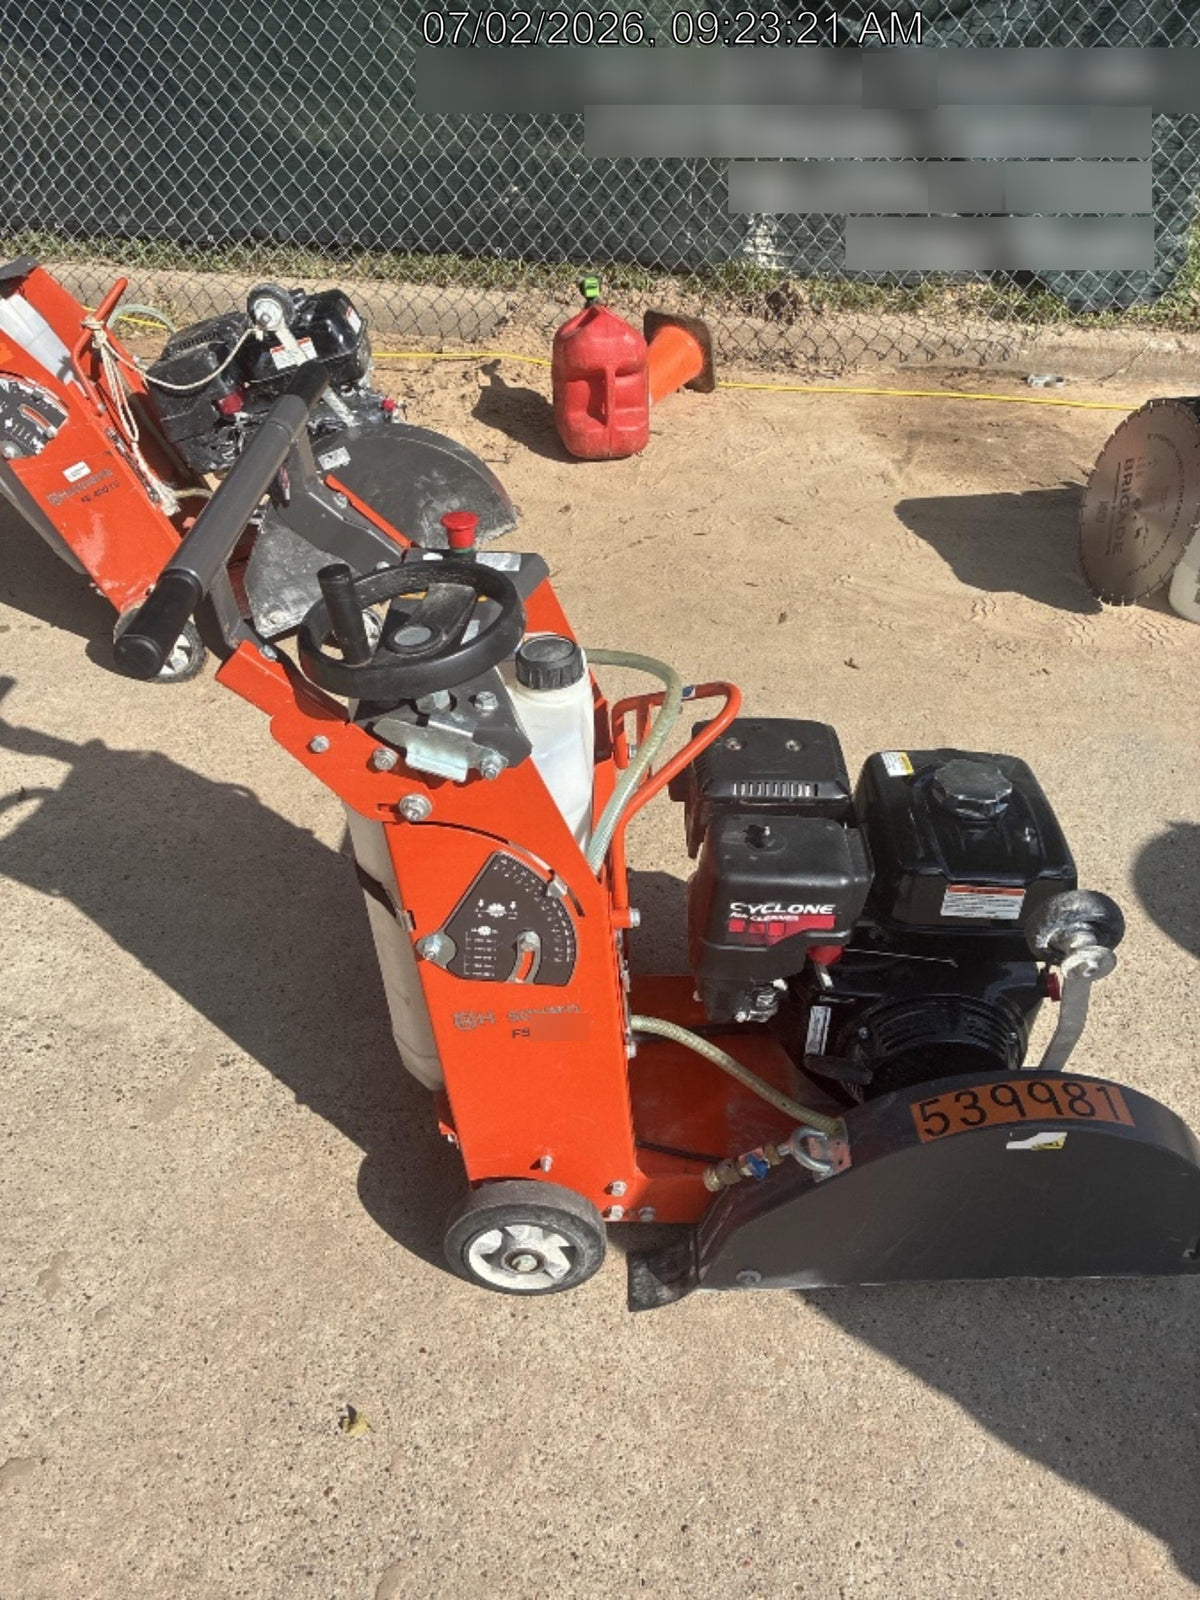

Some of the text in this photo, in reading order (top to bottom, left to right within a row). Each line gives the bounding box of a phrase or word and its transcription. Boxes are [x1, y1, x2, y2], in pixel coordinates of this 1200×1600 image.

[1112, 458, 1136, 554] BRIGADE
[730, 902, 836, 914] CYCLONE
[919, 1081, 1121, 1136] 539981
